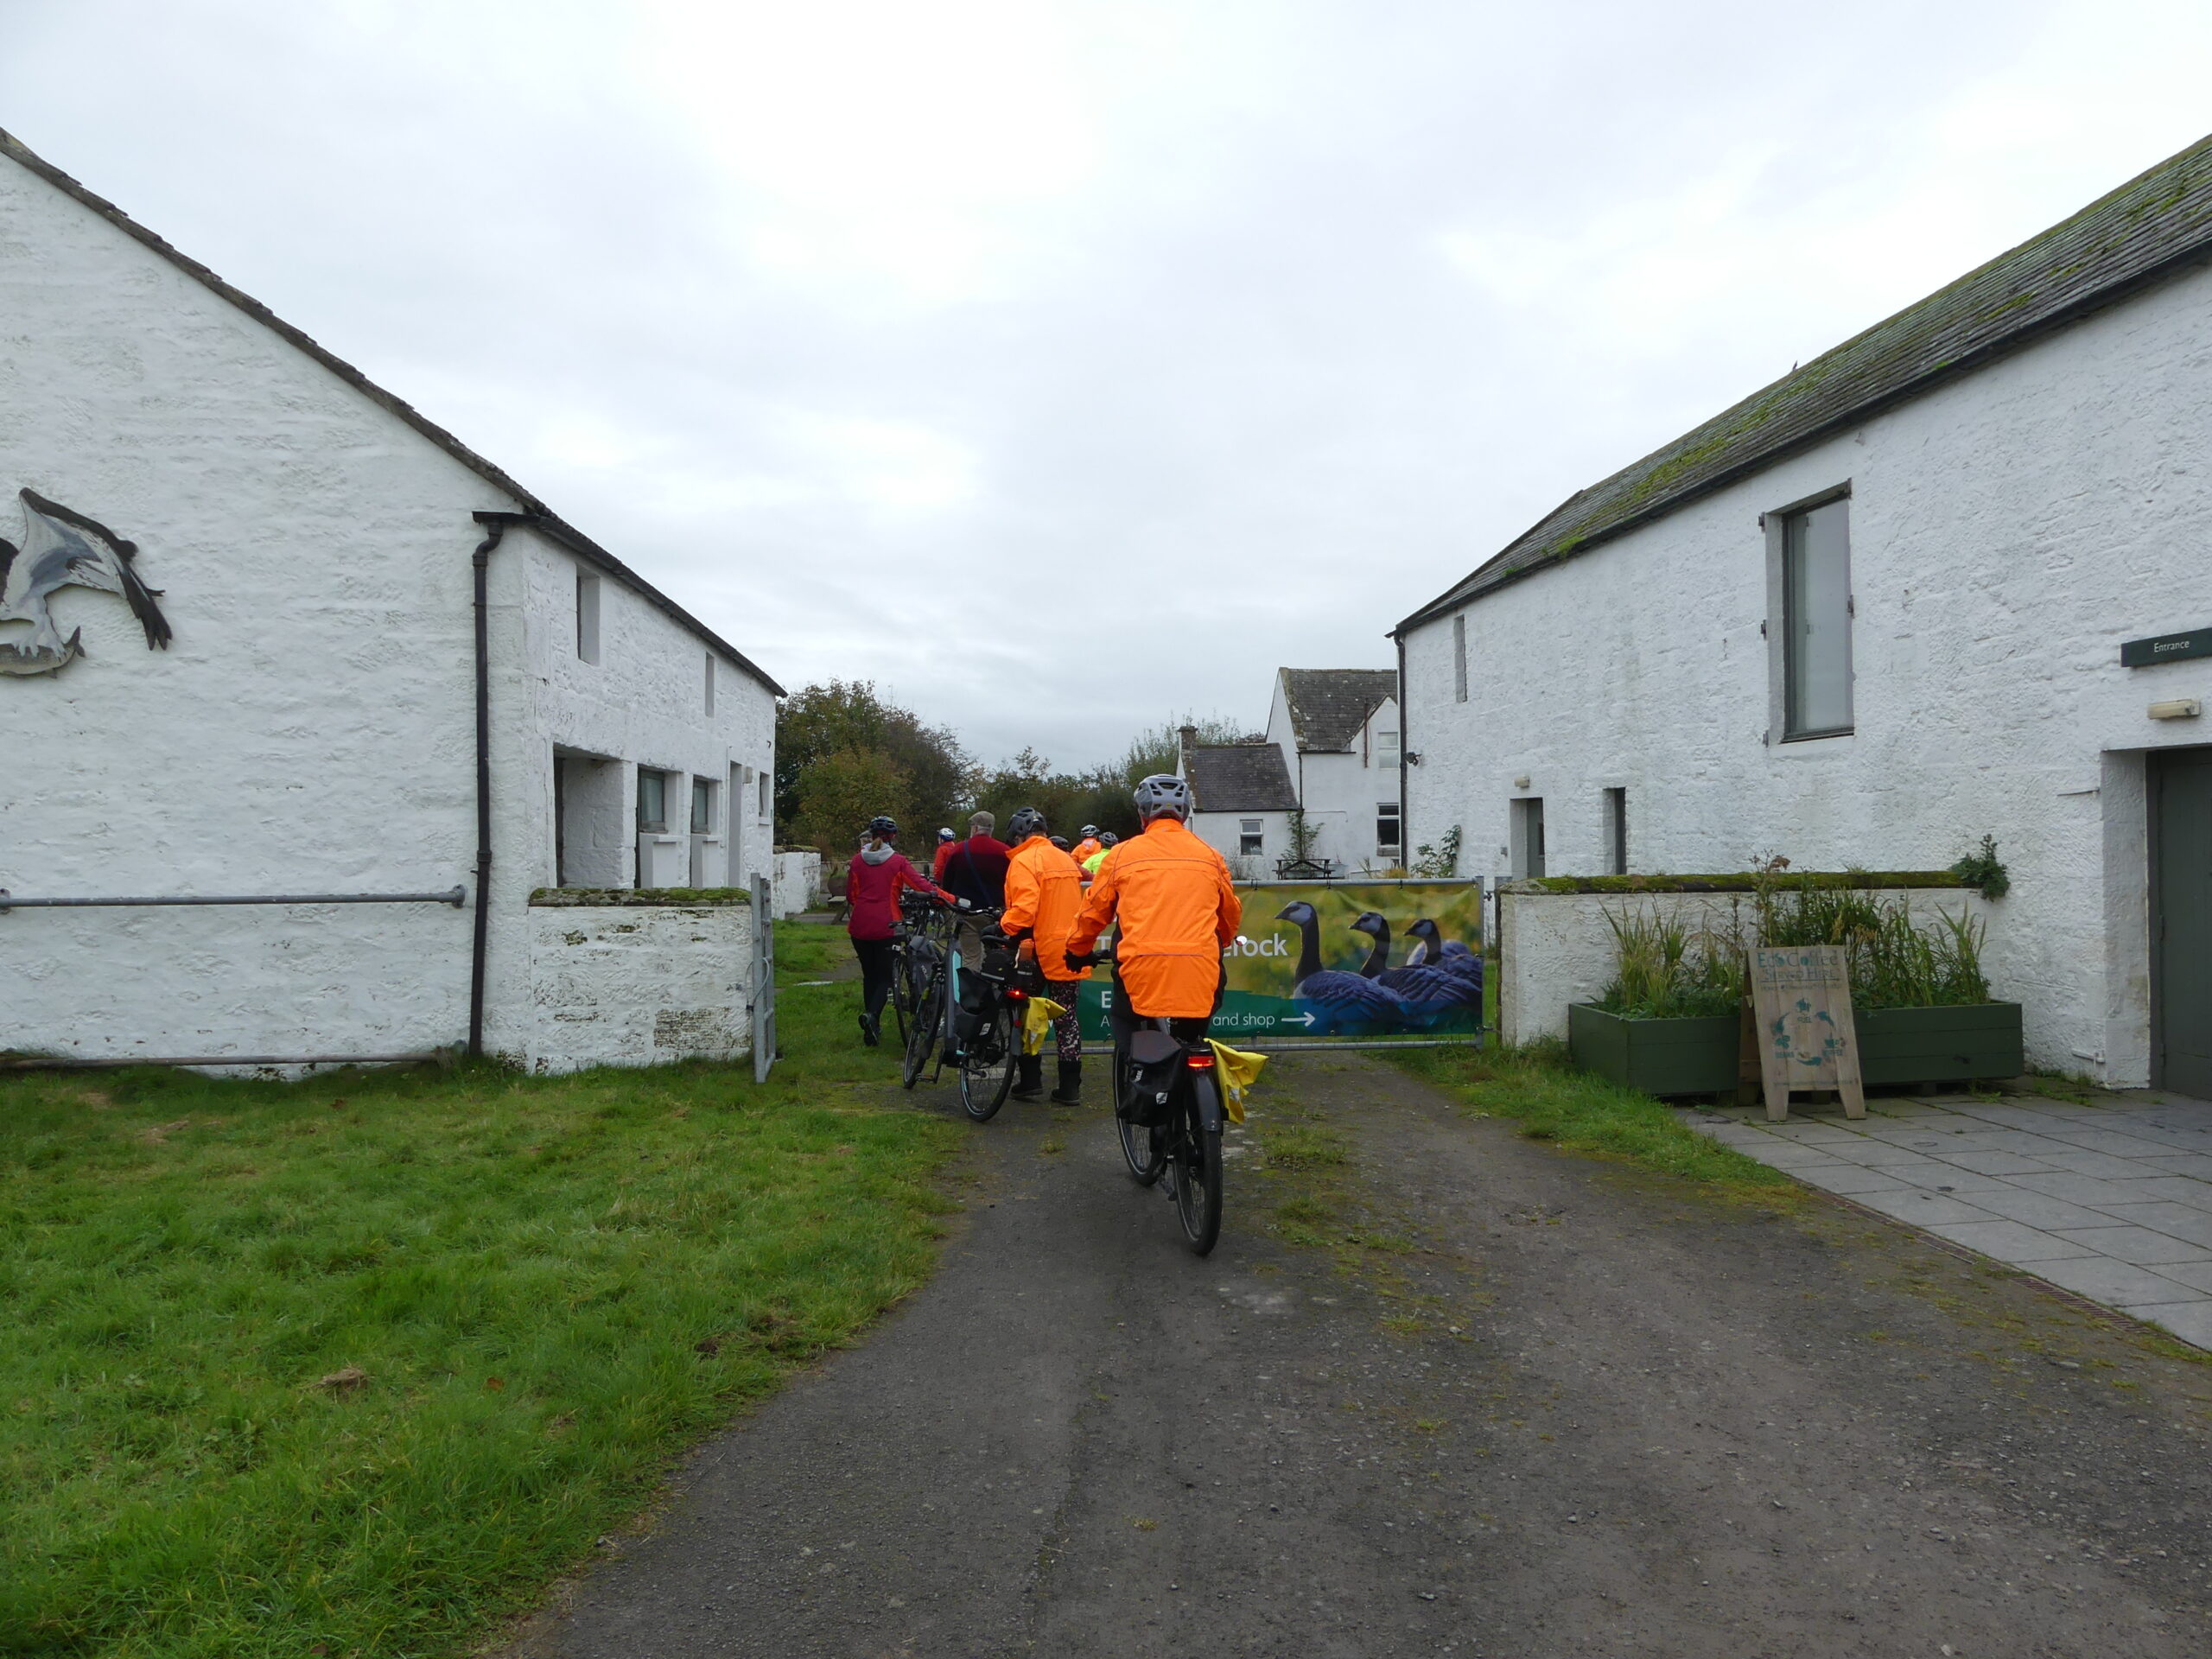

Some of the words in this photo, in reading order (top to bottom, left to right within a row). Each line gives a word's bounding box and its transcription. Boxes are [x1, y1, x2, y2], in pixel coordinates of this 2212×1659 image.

[2153, 640, 2190, 652] Entrance
[1212, 1013, 1239, 1026] and
[1243, 1013, 1275, 1028] shop
